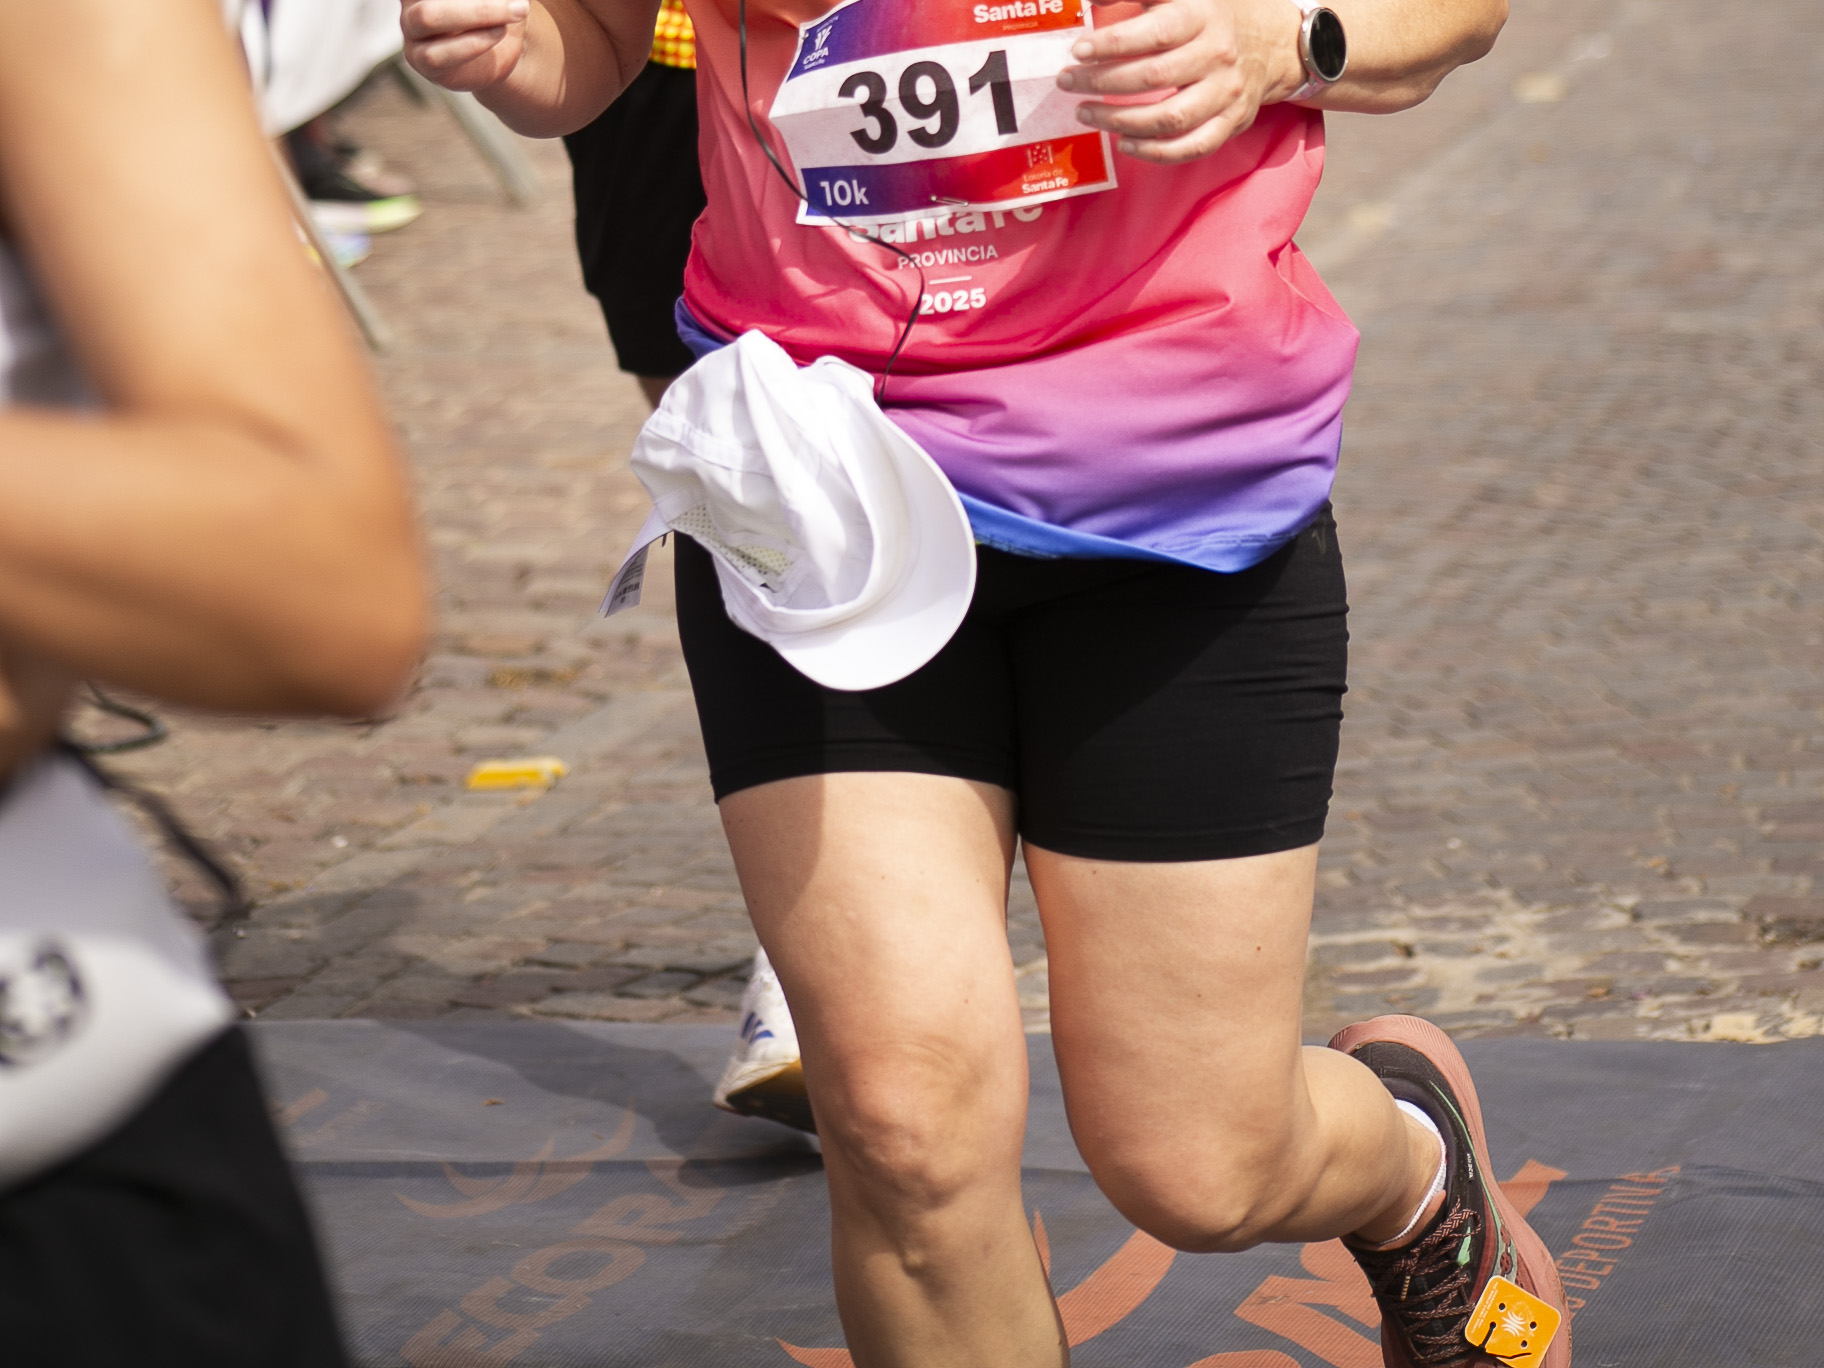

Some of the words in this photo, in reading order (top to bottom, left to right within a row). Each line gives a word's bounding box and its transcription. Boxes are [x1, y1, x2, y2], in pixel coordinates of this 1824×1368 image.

[803, 47, 829, 65] COPA
[838, 50, 1018, 155] 391
[820, 180, 870, 207] 10k
[898, 244, 999, 271] PROVINCIA
[919, 287, 987, 316] 2025
